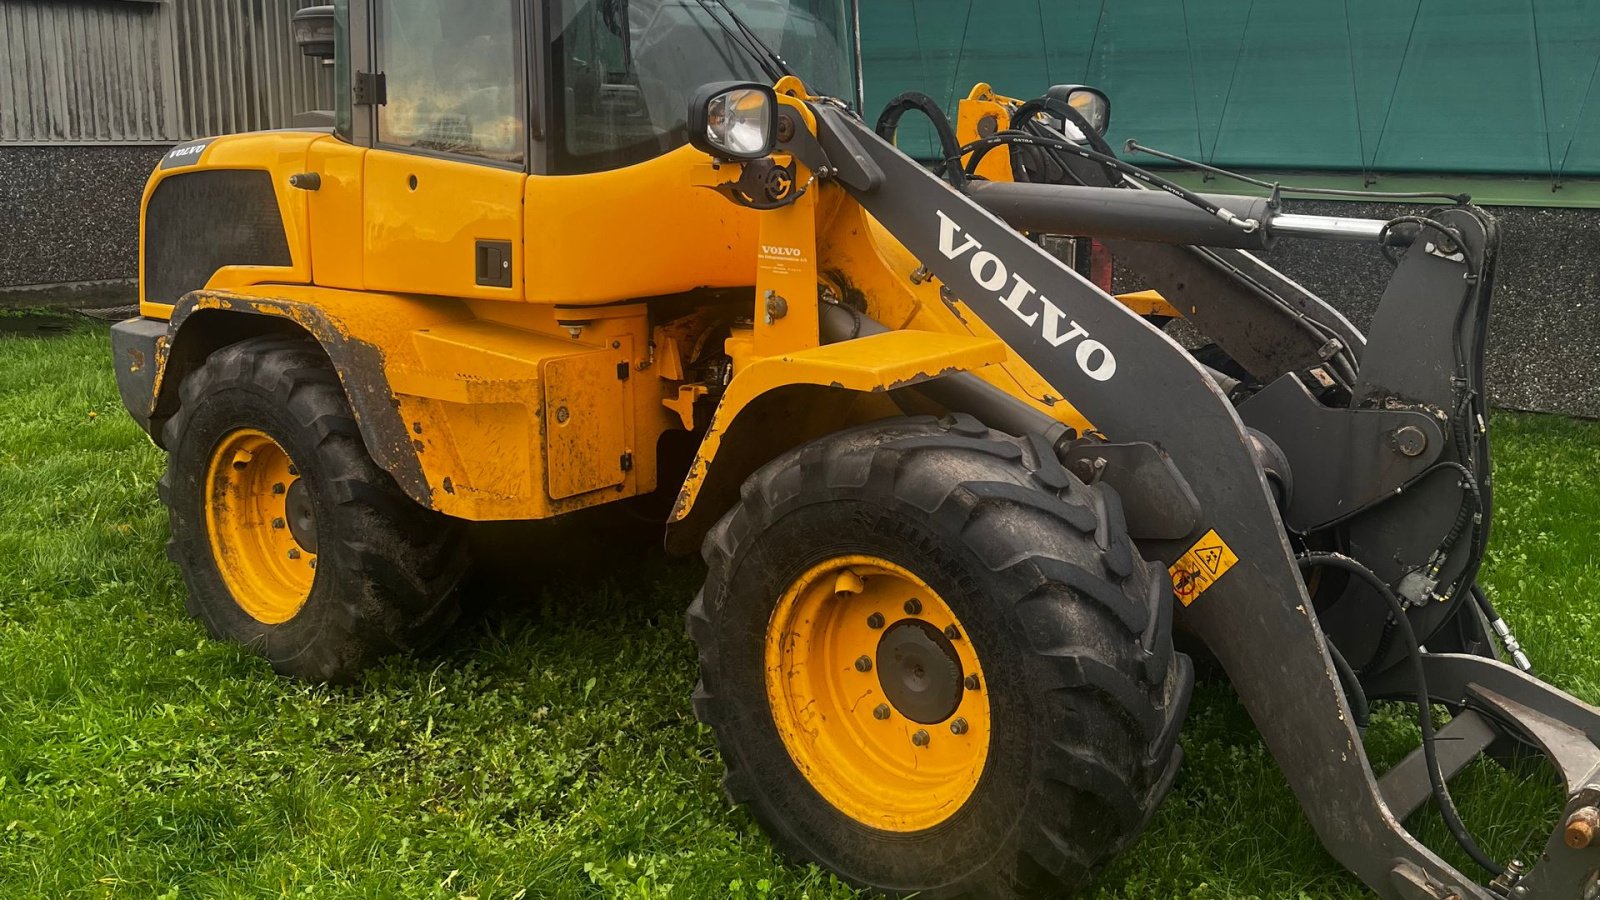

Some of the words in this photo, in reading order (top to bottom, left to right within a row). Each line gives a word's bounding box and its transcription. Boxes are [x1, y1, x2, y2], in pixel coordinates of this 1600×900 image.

[169, 145, 205, 158] VOLVO
[761, 245, 801, 256] VOLVO
[936, 209, 1117, 382] VOLVO
